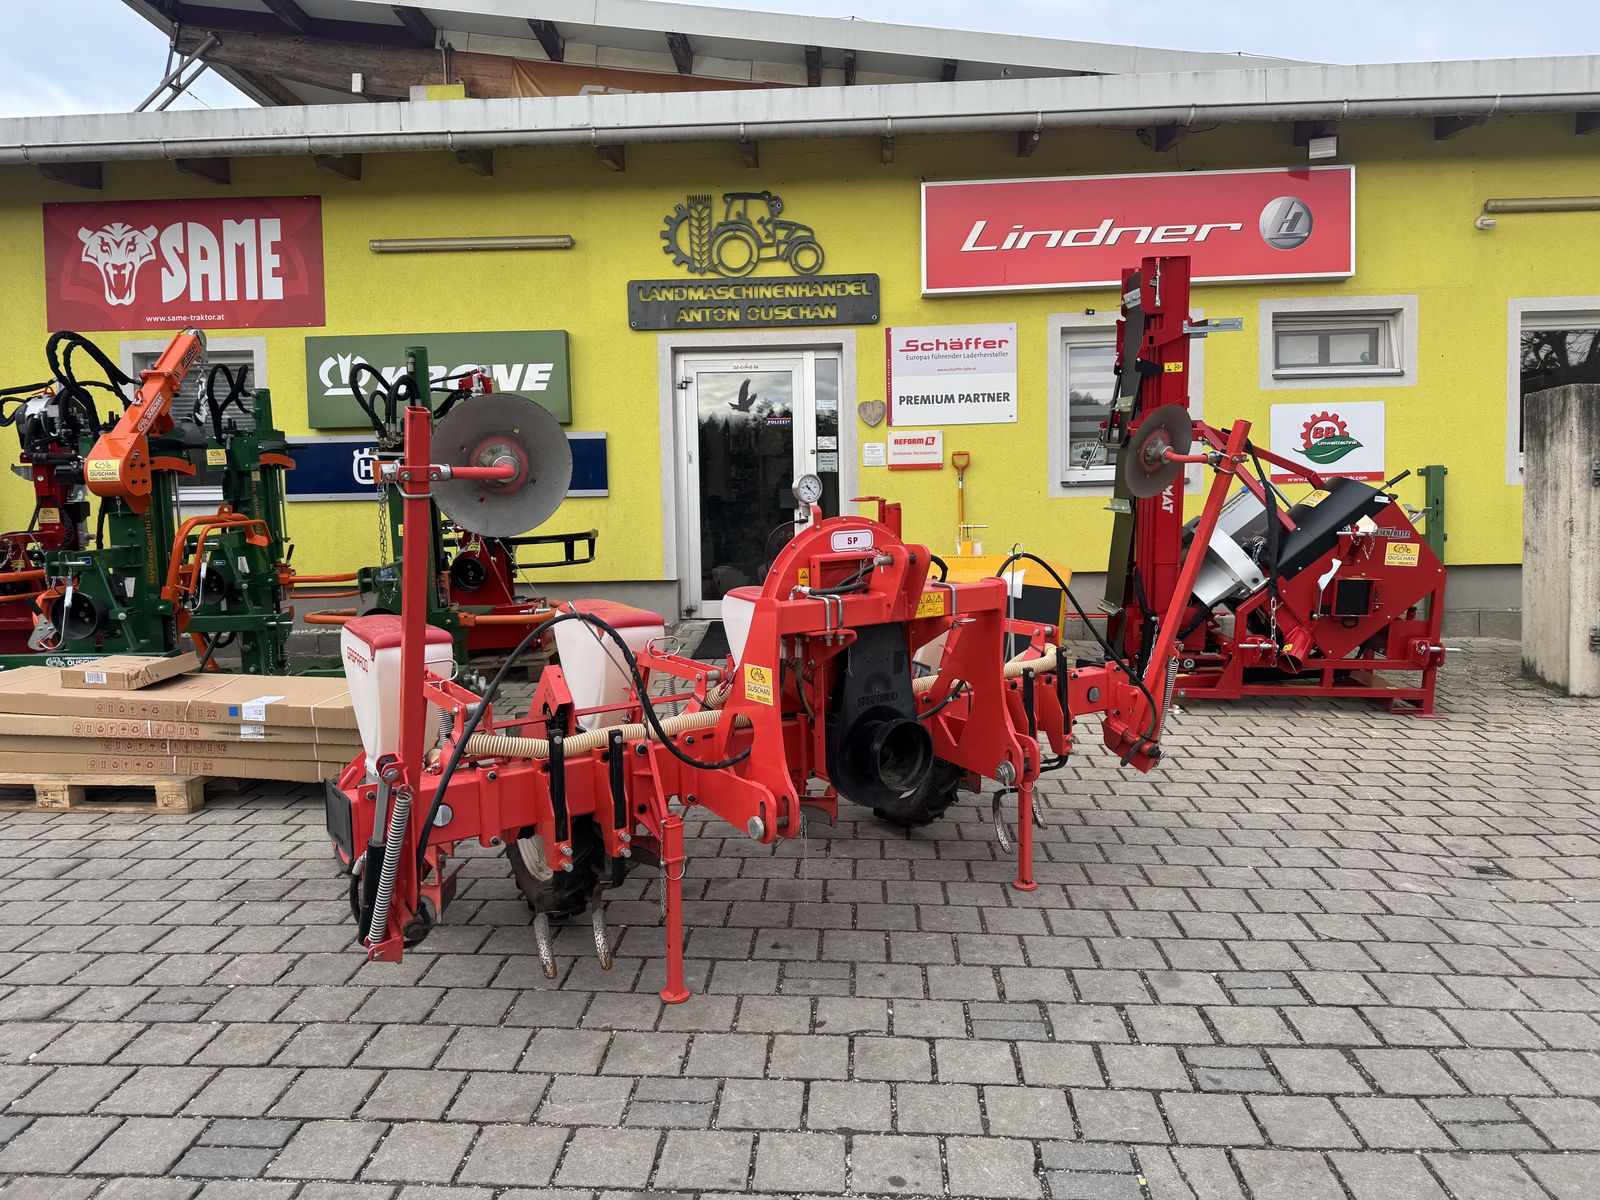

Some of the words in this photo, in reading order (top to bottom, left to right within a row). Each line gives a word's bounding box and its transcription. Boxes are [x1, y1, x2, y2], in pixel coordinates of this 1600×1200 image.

[960, 219, 1243, 251] Lindner
[159, 218, 284, 303] SAME
[638, 280, 873, 302] LANDMASCHINENHANDEL
[676, 306, 740, 322] ANTON
[747, 303, 838, 320] OUSCHAN
[146, 314, 225, 322] www.same-traktor.at
[899, 337, 1009, 352] Schäffer
[931, 352, 962, 360] führender
[963, 351, 1009, 359] Laderhersteller
[899, 394, 956, 405] PREMIUM
[958, 392, 1010, 404] PARTNER
[1312, 427, 1336, 438] BB
[847, 537, 858, 545] SP
[206, 709, 217, 718] 2/2
[190, 727, 199, 736] 1/2
[217, 743, 228, 752] 1/2
[203, 762, 214, 771] 2/2
